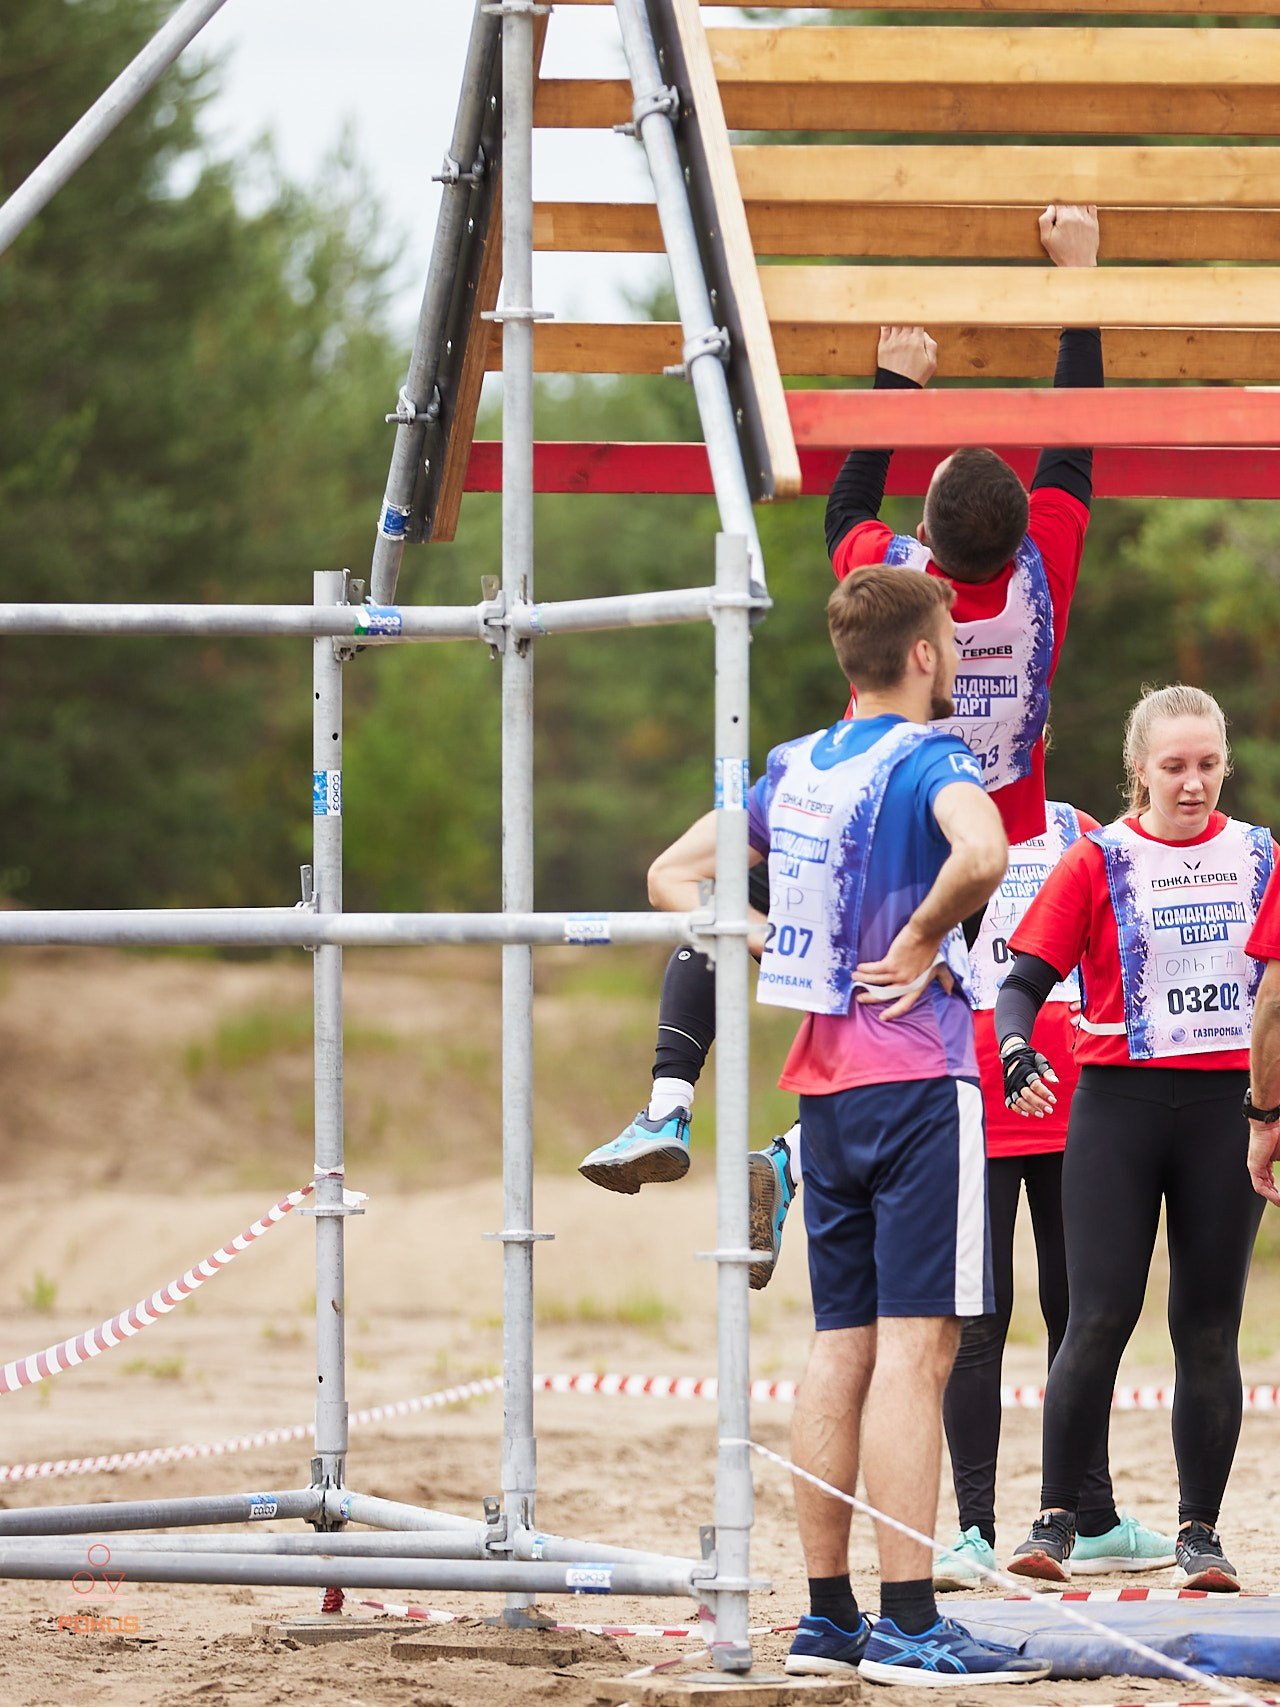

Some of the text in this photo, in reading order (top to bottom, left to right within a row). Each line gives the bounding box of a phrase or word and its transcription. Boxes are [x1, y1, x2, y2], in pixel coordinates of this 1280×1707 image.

[962, 645, 1013, 658] ГЕРОЕВ
[952, 675, 1016, 698] НДНЫЙ
[952, 698, 988, 716] ТАРТ
[804, 798, 834, 815] ГЕРОЕВ
[1001, 881, 1040, 897] СТАРТ
[1151, 872, 1238, 889] ГОНКА ГЕРОЕВ
[1153, 900, 1246, 927] КОМАНДНЫЙ
[763, 922, 814, 959] 207
[1182, 923, 1226, 943] СТАРТ
[1165, 951, 1234, 976] ОЛЬГА
[1167, 983, 1240, 1016] 03202
